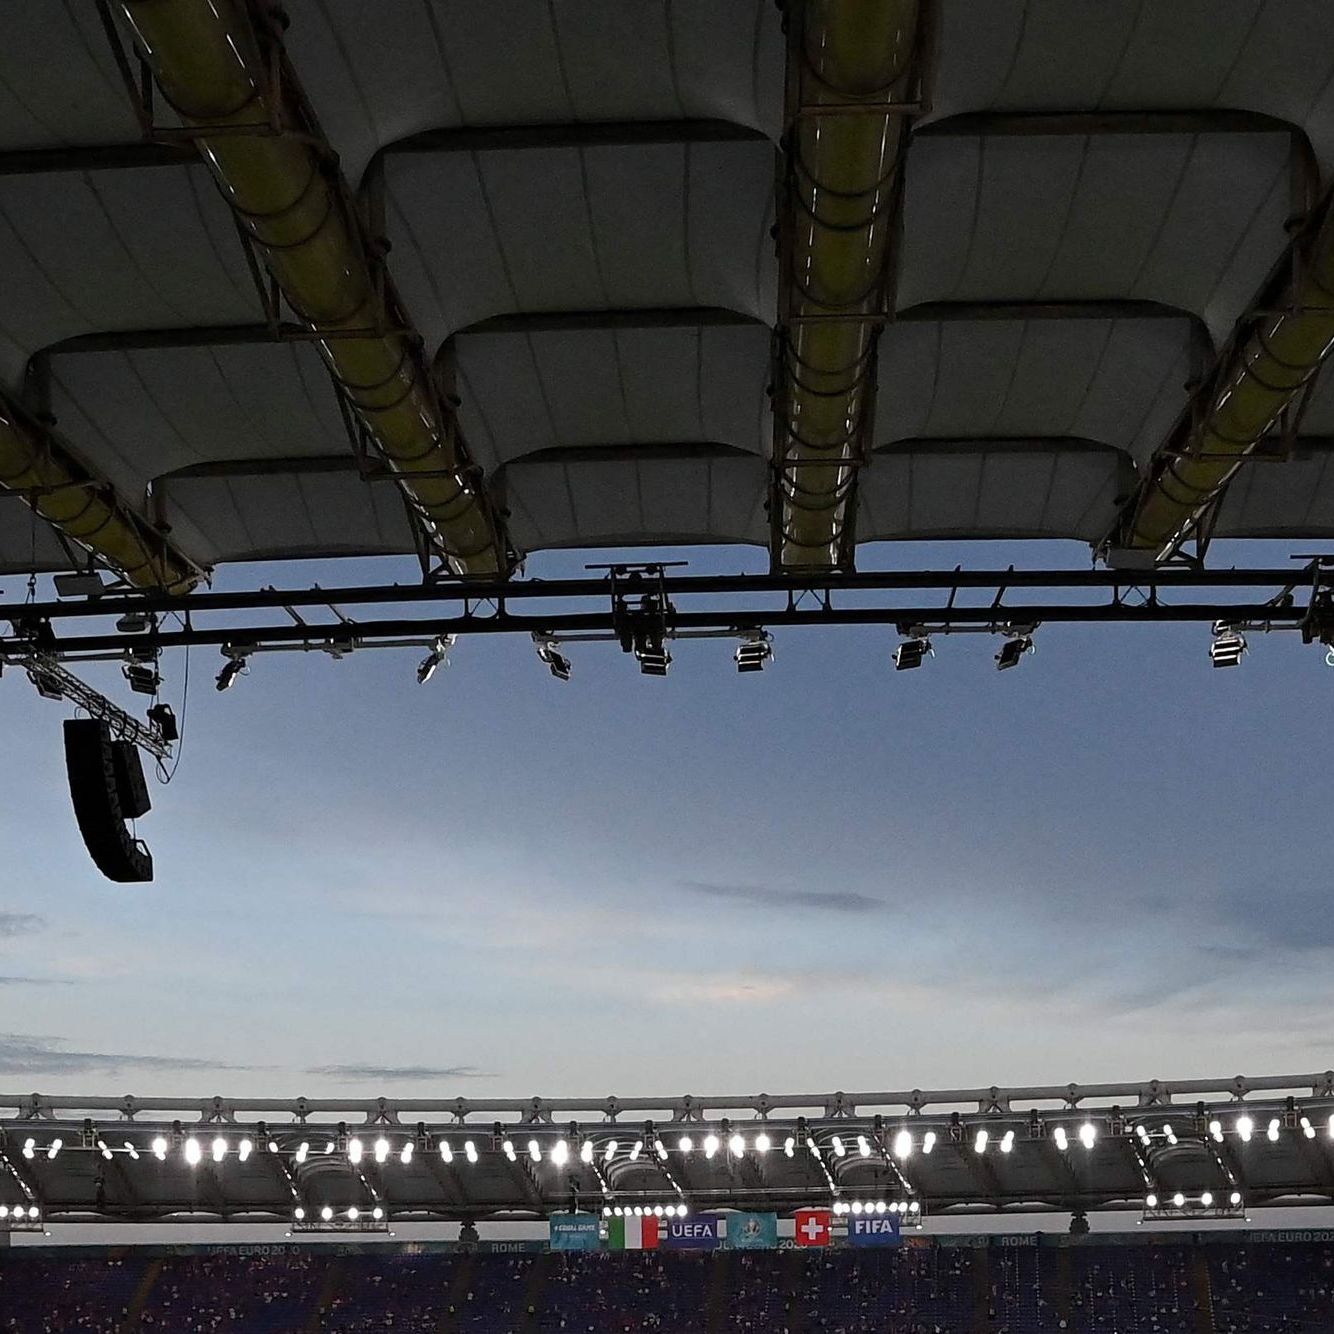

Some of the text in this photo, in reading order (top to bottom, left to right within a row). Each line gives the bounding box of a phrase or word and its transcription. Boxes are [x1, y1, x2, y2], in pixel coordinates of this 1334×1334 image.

[672, 1225, 712, 1237] UEFA
[855, 1220, 893, 1234] FIFA
[1001, 1236, 1037, 1247] ROME
[1278, 1231, 1311, 1242] EURO
[239, 1246, 269, 1255] EURO
[271, 1245, 300, 1255] 200
[492, 1243, 525, 1253] ROME
